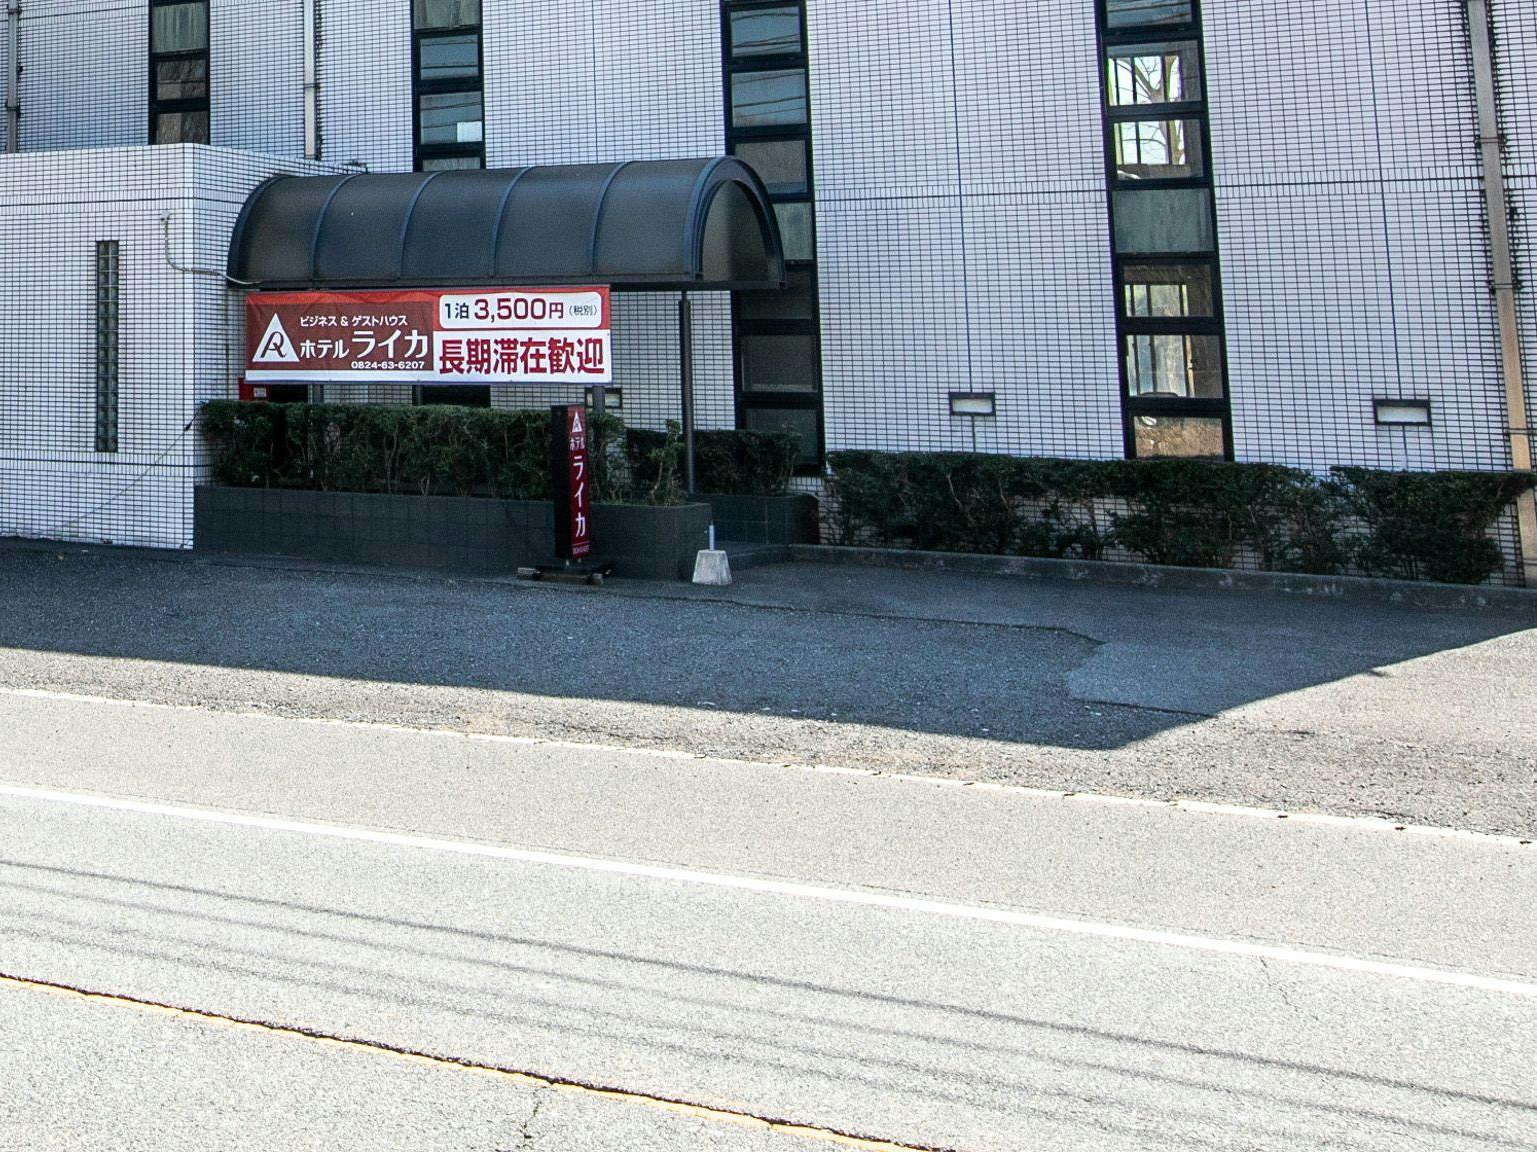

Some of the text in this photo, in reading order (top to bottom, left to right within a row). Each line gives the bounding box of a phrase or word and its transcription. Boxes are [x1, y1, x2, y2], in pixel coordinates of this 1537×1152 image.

[300, 315, 408, 327] ビジネス & ゲストハウス
[444, 302, 469, 320] 1泊
[474, 298, 564, 323] 3,500円
[300, 329, 429, 359] ホテル ライカ
[439, 337, 605, 375] 長期滞在歓迎
[351, 361, 425, 370] 0824-63-6207
[573, 455, 586, 537] ライカ
